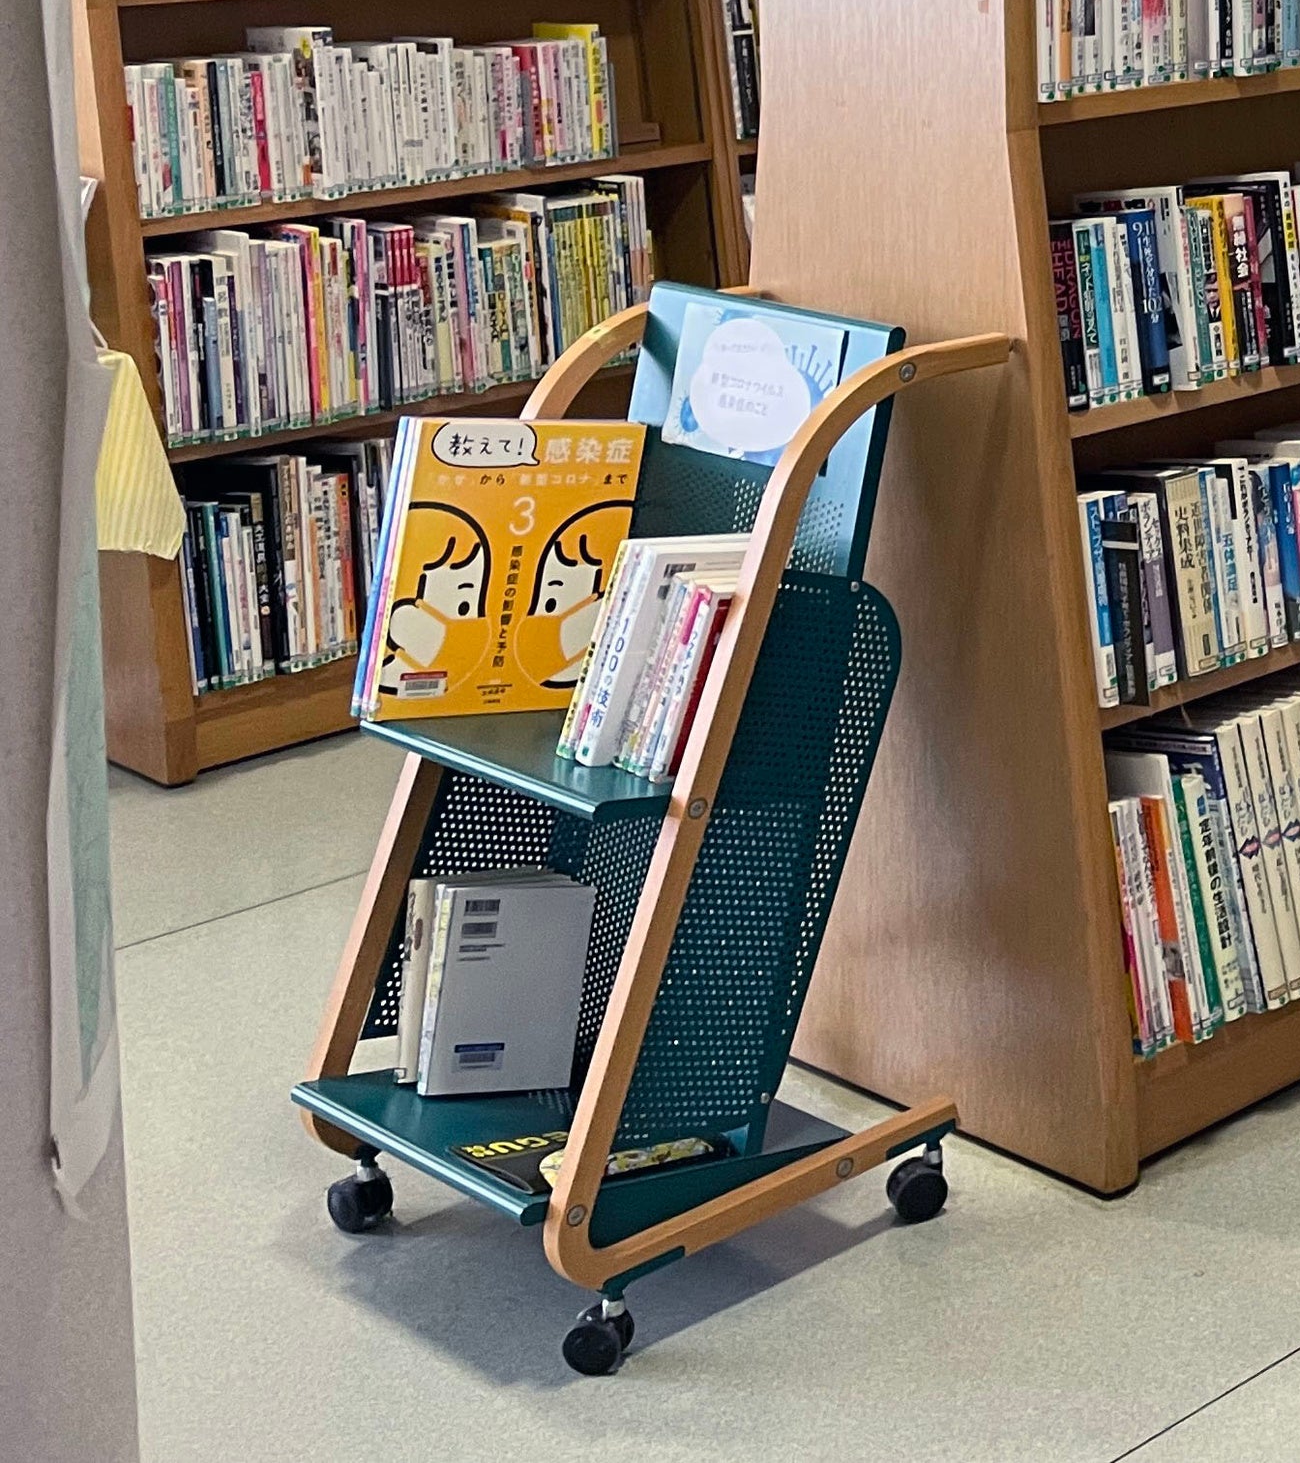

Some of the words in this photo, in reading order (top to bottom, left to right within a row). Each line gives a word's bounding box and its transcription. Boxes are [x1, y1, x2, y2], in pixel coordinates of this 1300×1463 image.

[1231, 215, 1250, 280] 社会
[448, 431, 526, 458] 教えて!
[544, 436, 636, 466] 感染症
[508, 495, 537, 538] 3
